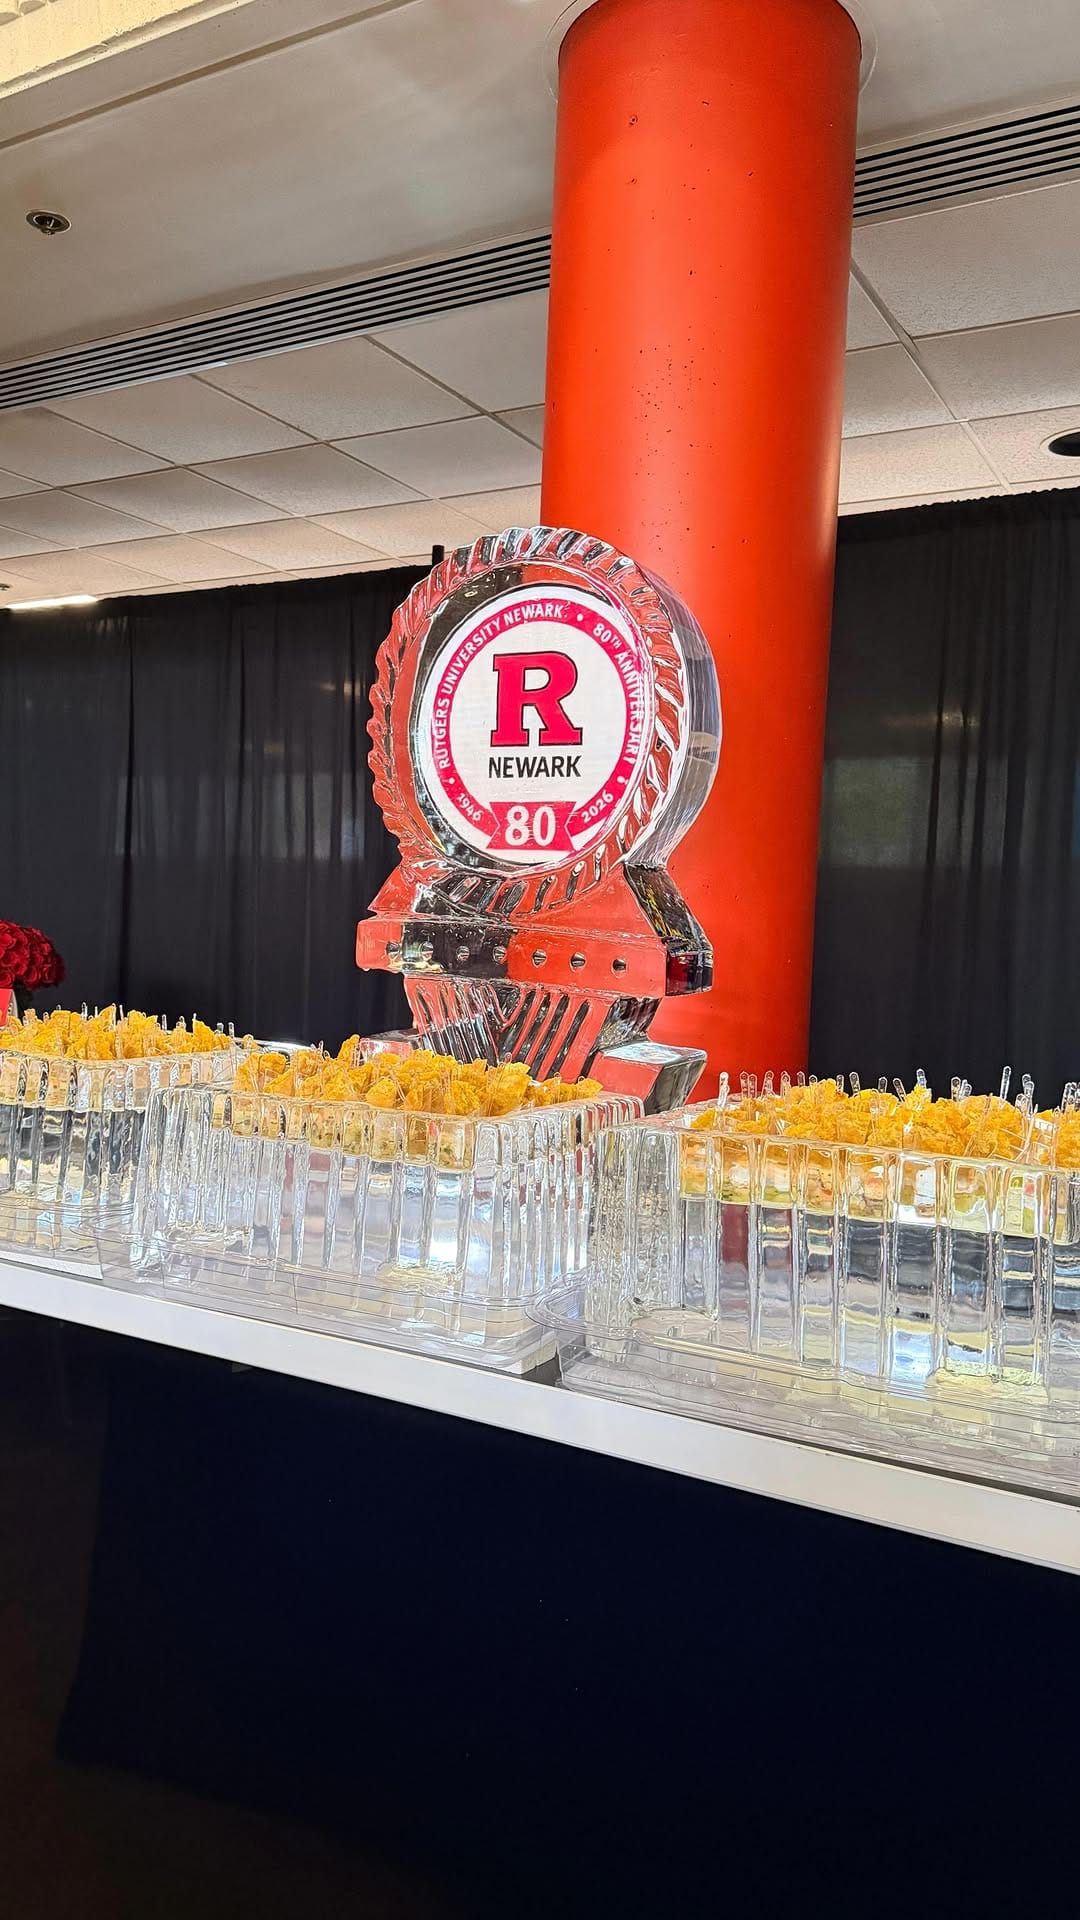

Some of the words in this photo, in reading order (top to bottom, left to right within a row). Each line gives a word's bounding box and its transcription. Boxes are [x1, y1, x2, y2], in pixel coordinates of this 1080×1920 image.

[593, 623, 622, 649] 80TH
[433, 698, 451, 769] RUTGERS
[444, 619, 501, 694] UNIVERSITY
[504, 603, 564, 627] NEWARK
[490, 651, 583, 747] R
[488, 755, 582, 779] NEWARK
[456, 793, 483, 822] 1946
[581, 790, 614, 823] 2026
[504, 805, 556, 846] 80
